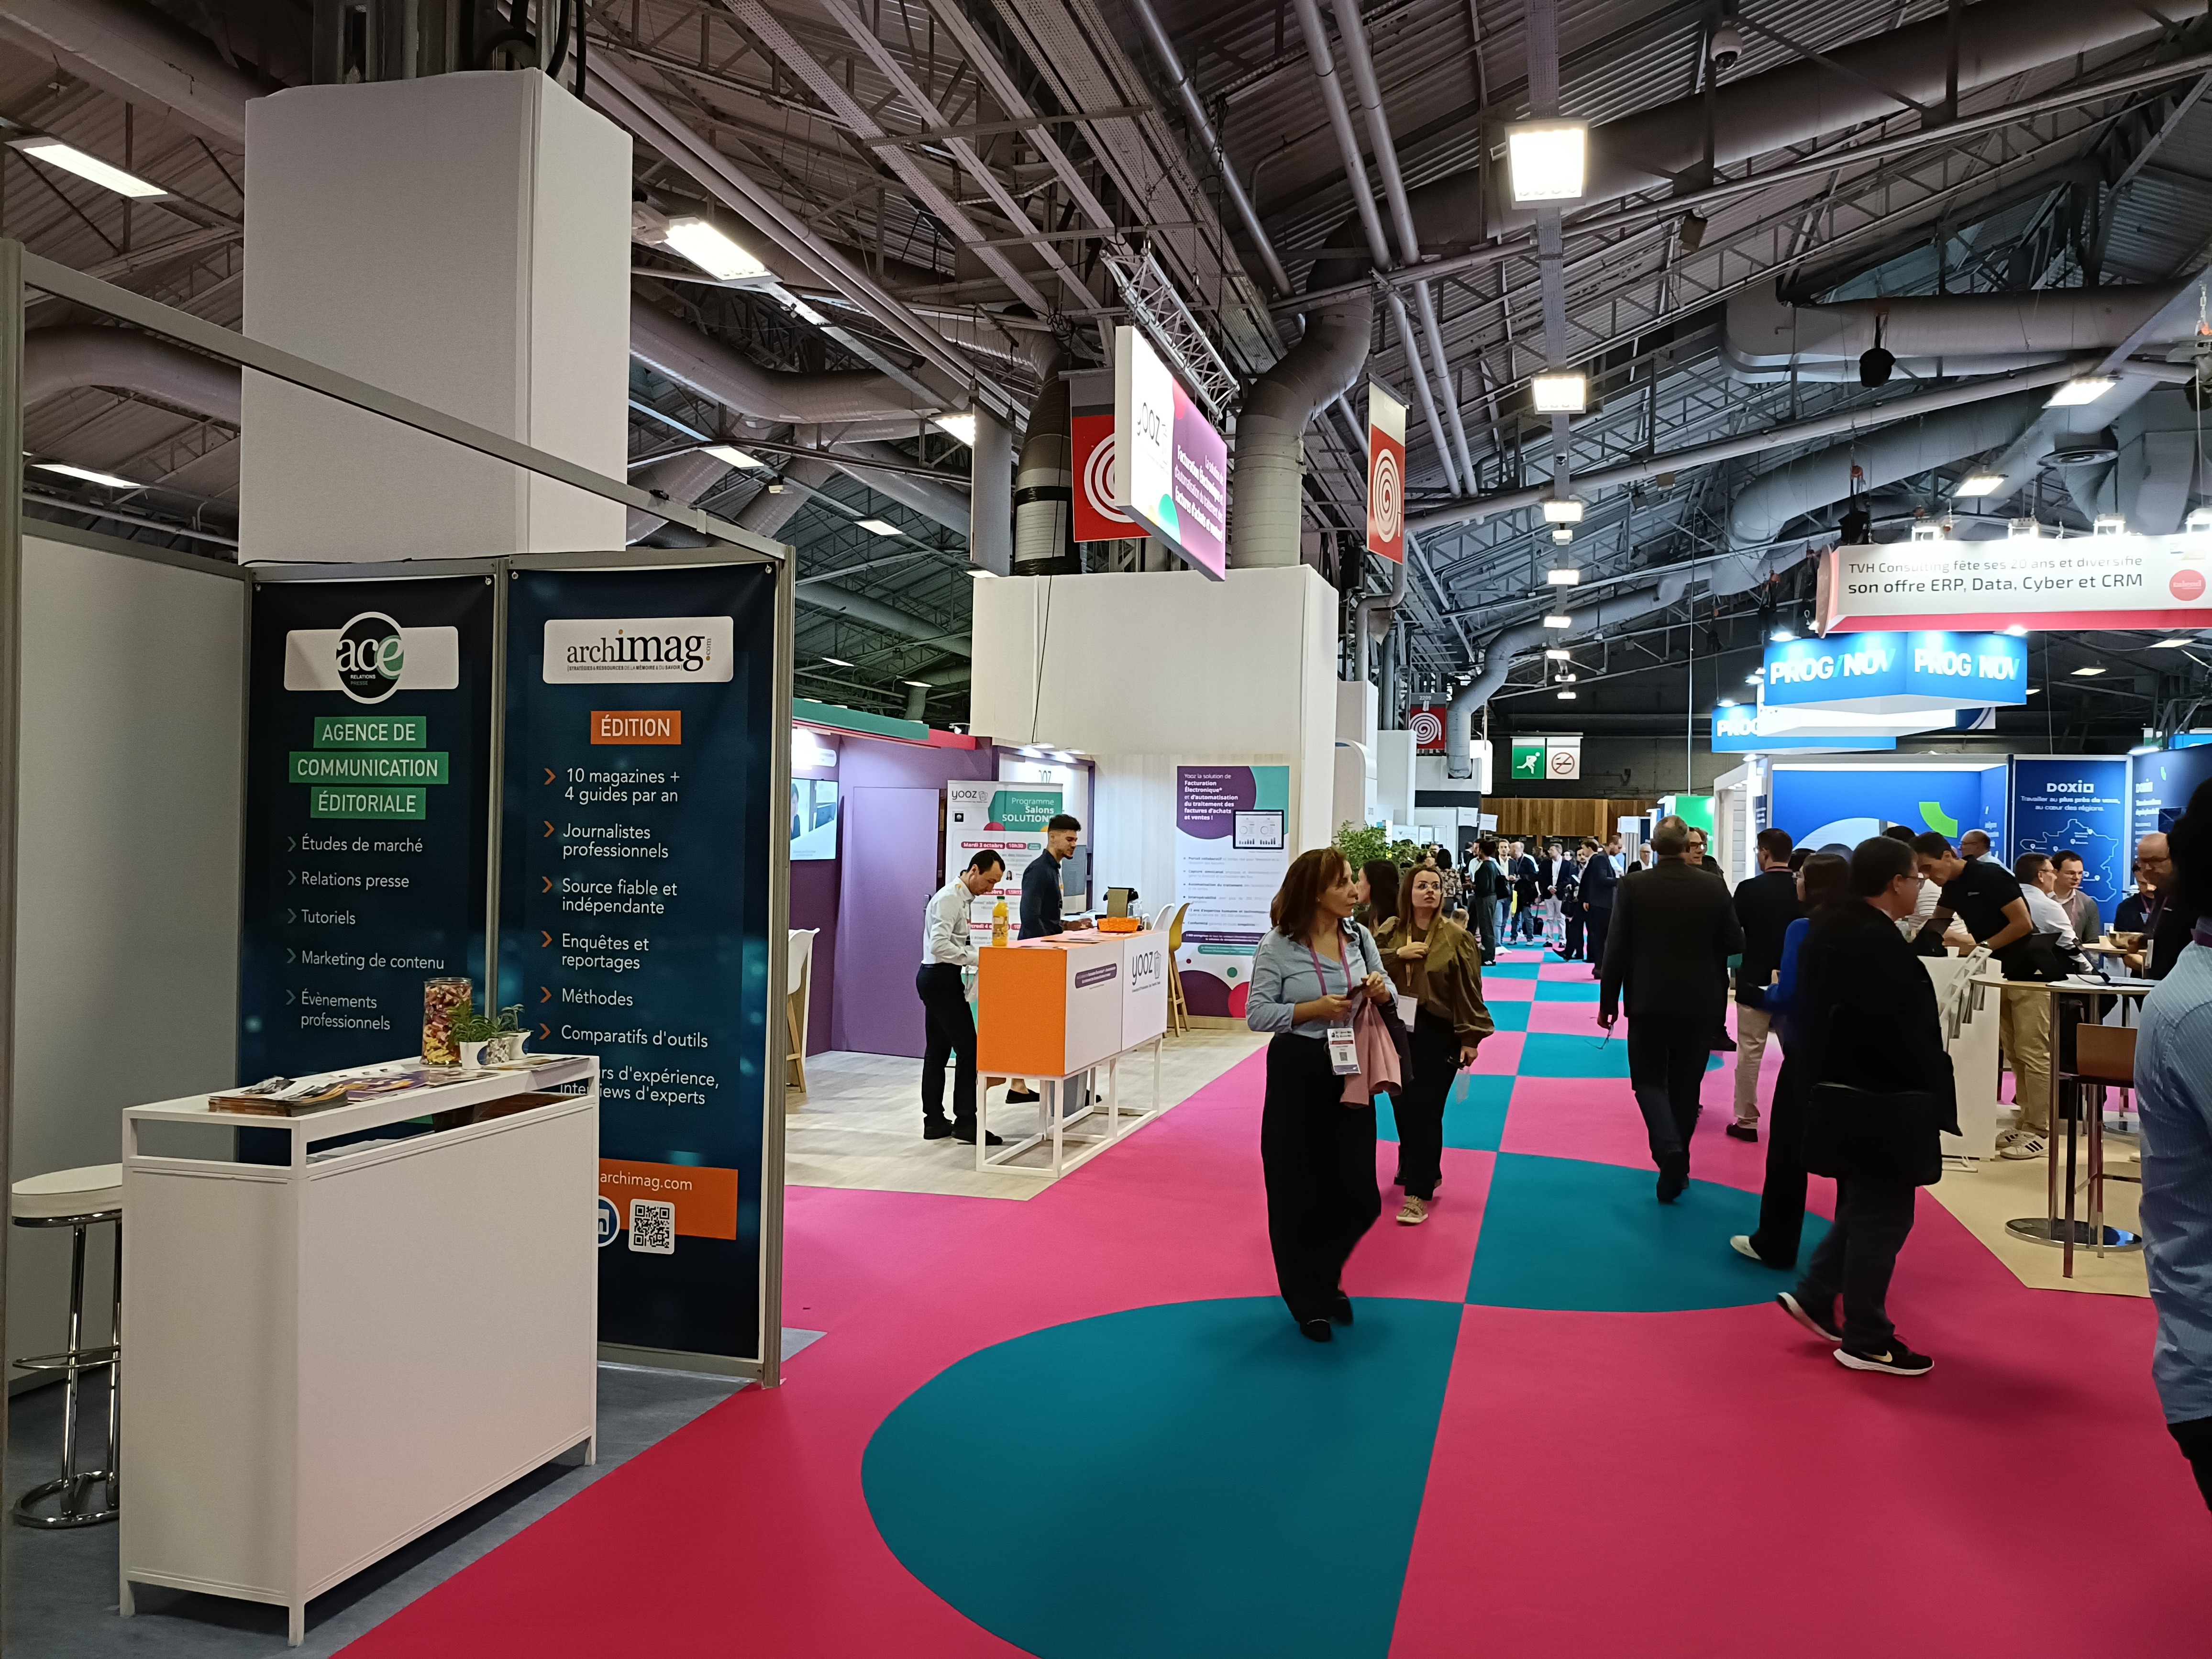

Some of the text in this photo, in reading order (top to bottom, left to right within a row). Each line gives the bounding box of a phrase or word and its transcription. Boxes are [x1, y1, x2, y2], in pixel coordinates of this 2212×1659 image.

[1848, 556, 2142, 574] TVH Consulting fête ses 20 ans et diversifie
[1848, 574, 2143, 594] son offre ERP, Data, Cyber et CRM
[336, 637, 405, 677] ace
[567, 629, 705, 672] archimag
[322, 724, 416, 741] AGENCE DE
[601, 714, 670, 737] ÉDITION
[297, 759, 438, 777] COMMUNICATION
[567, 767, 680, 787] 10 magazines +
[318, 791, 416, 812] ÉDITORIALE
[564, 786, 678, 806] 4 guides par an
[951, 790, 977, 800] yooz
[1011, 797, 1054, 807] Programme
[563, 823, 651, 840] Journalistes
[301, 833, 423, 852] Études de marché
[563, 841, 669, 860] professionnels
[301, 871, 409, 890] Relations presse
[562, 877, 677, 896] Source fiable et
[562, 896, 665, 916] indépendante
[301, 908, 356, 925] Tutoriels
[562, 932, 649, 952] Enquêtes et
[301, 950, 444, 971] Marketing de contenu
[562, 955, 641, 973] reportages
[1131, 951, 1153, 986] yooz
[301, 988, 377, 1009] Évènements
[562, 987, 633, 1006] Méthodes
[300, 1012, 391, 1030] professionnels
[561, 1024, 708, 1048] Comparatifs d'outils
[618, 1065, 719, 1089] d'expérience,
[635, 1086, 706, 1106] d'experts
[600, 1170, 693, 1192] archimag.com
